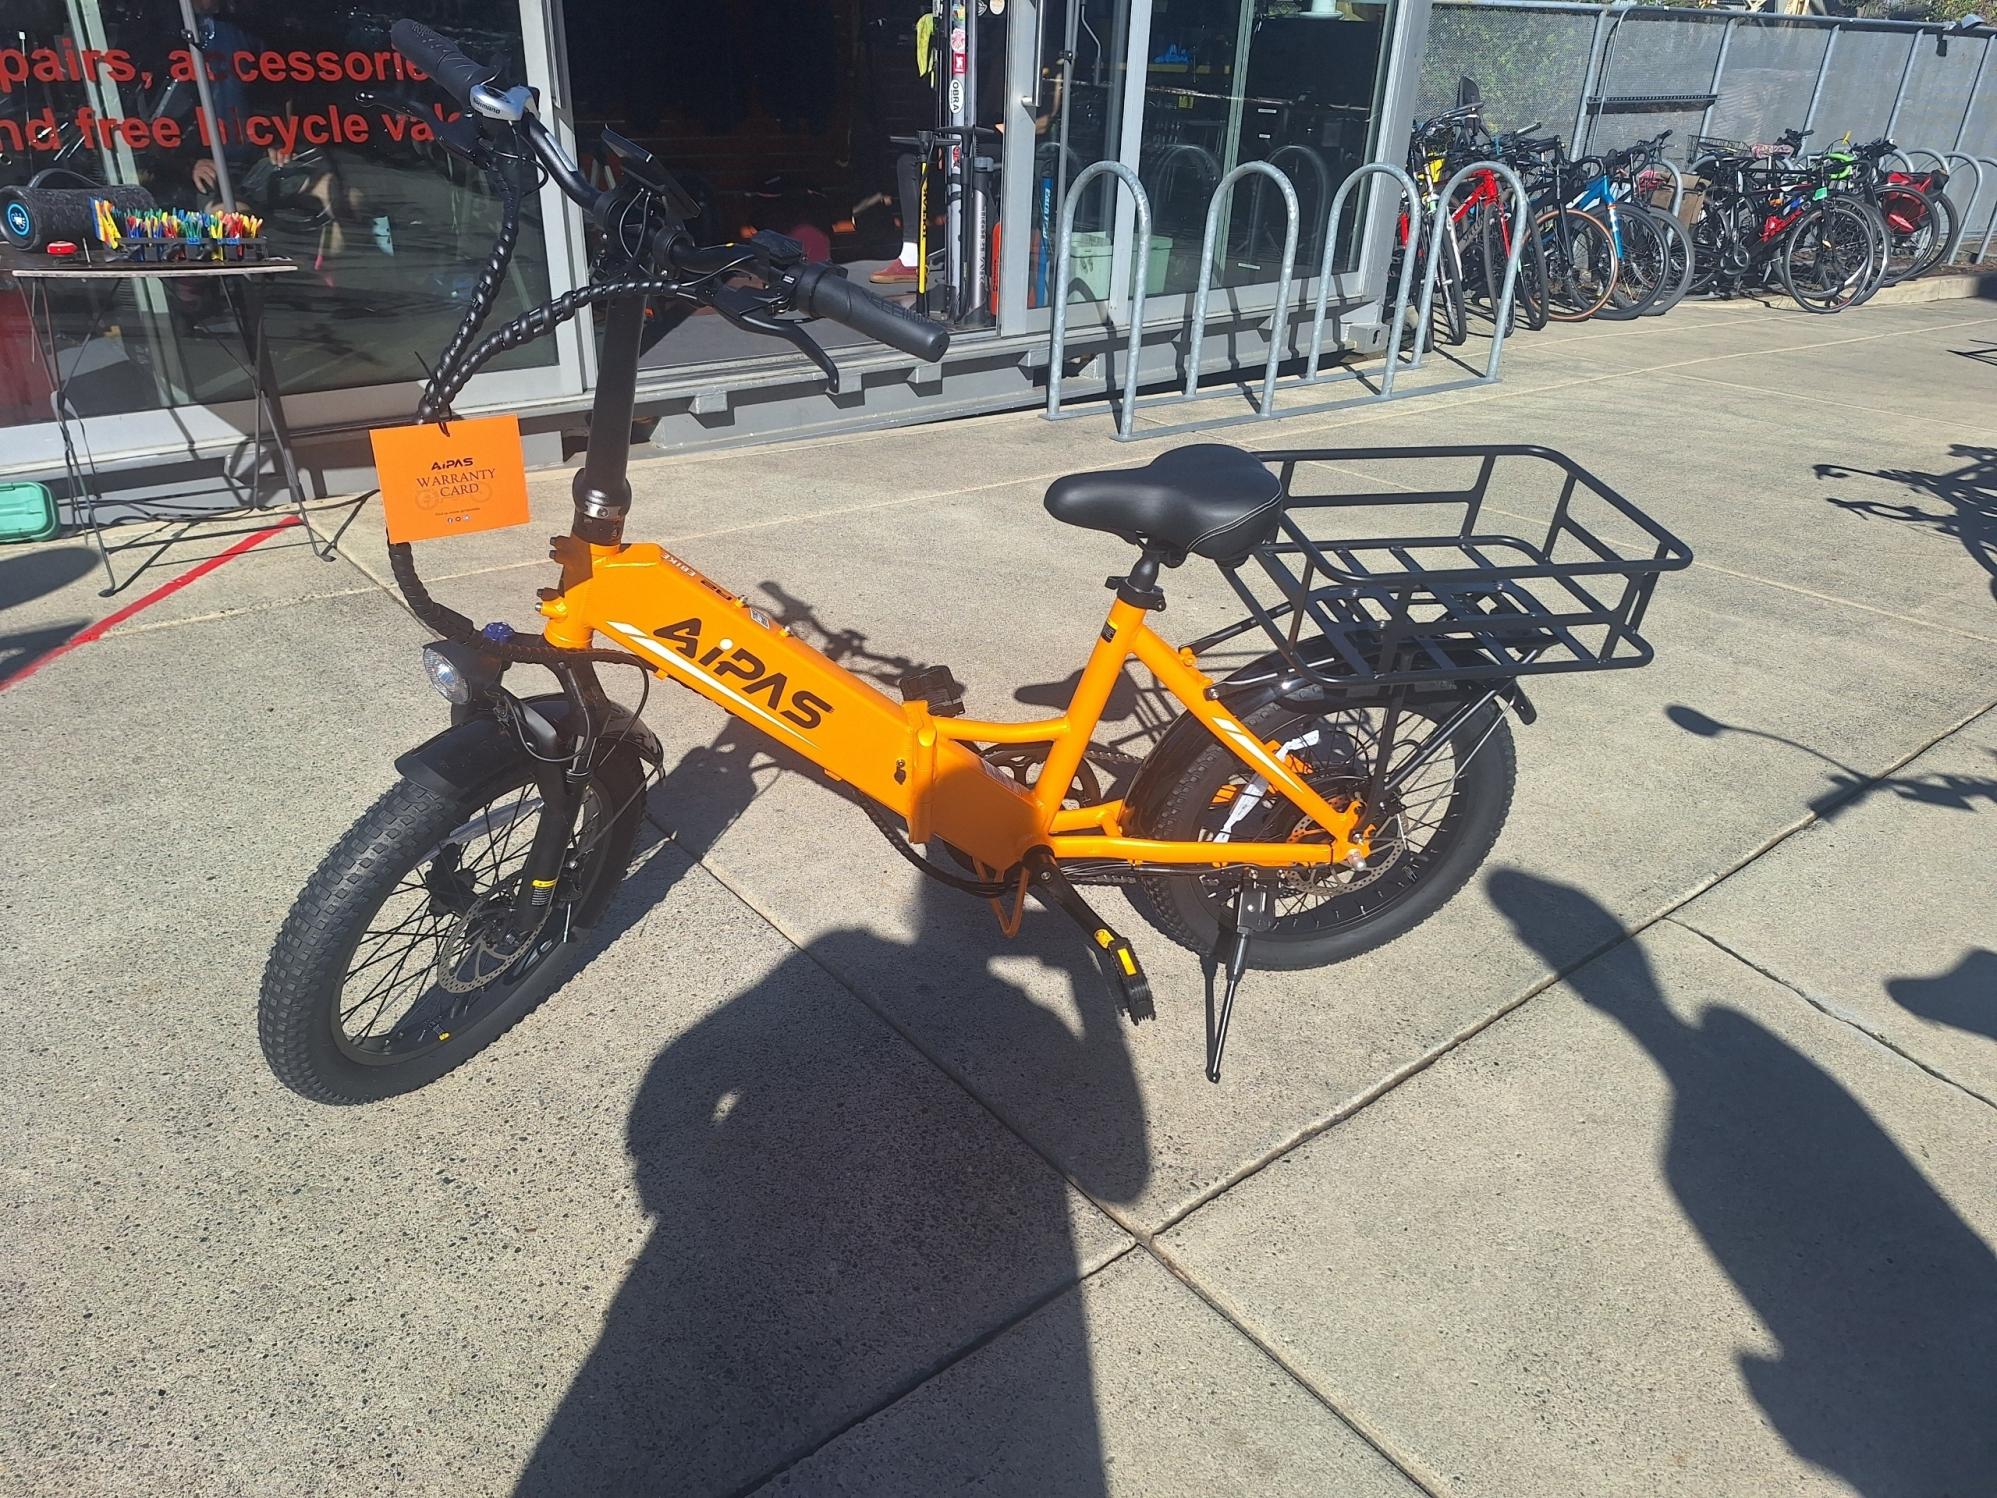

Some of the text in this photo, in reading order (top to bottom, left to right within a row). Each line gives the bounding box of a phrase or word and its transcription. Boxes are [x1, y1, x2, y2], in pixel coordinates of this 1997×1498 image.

[952, 81, 960, 110] OBRA
[75, 105, 182, 149] free
[416, 468, 496, 488] WARRANTY
[440, 483, 479, 498] CARD
